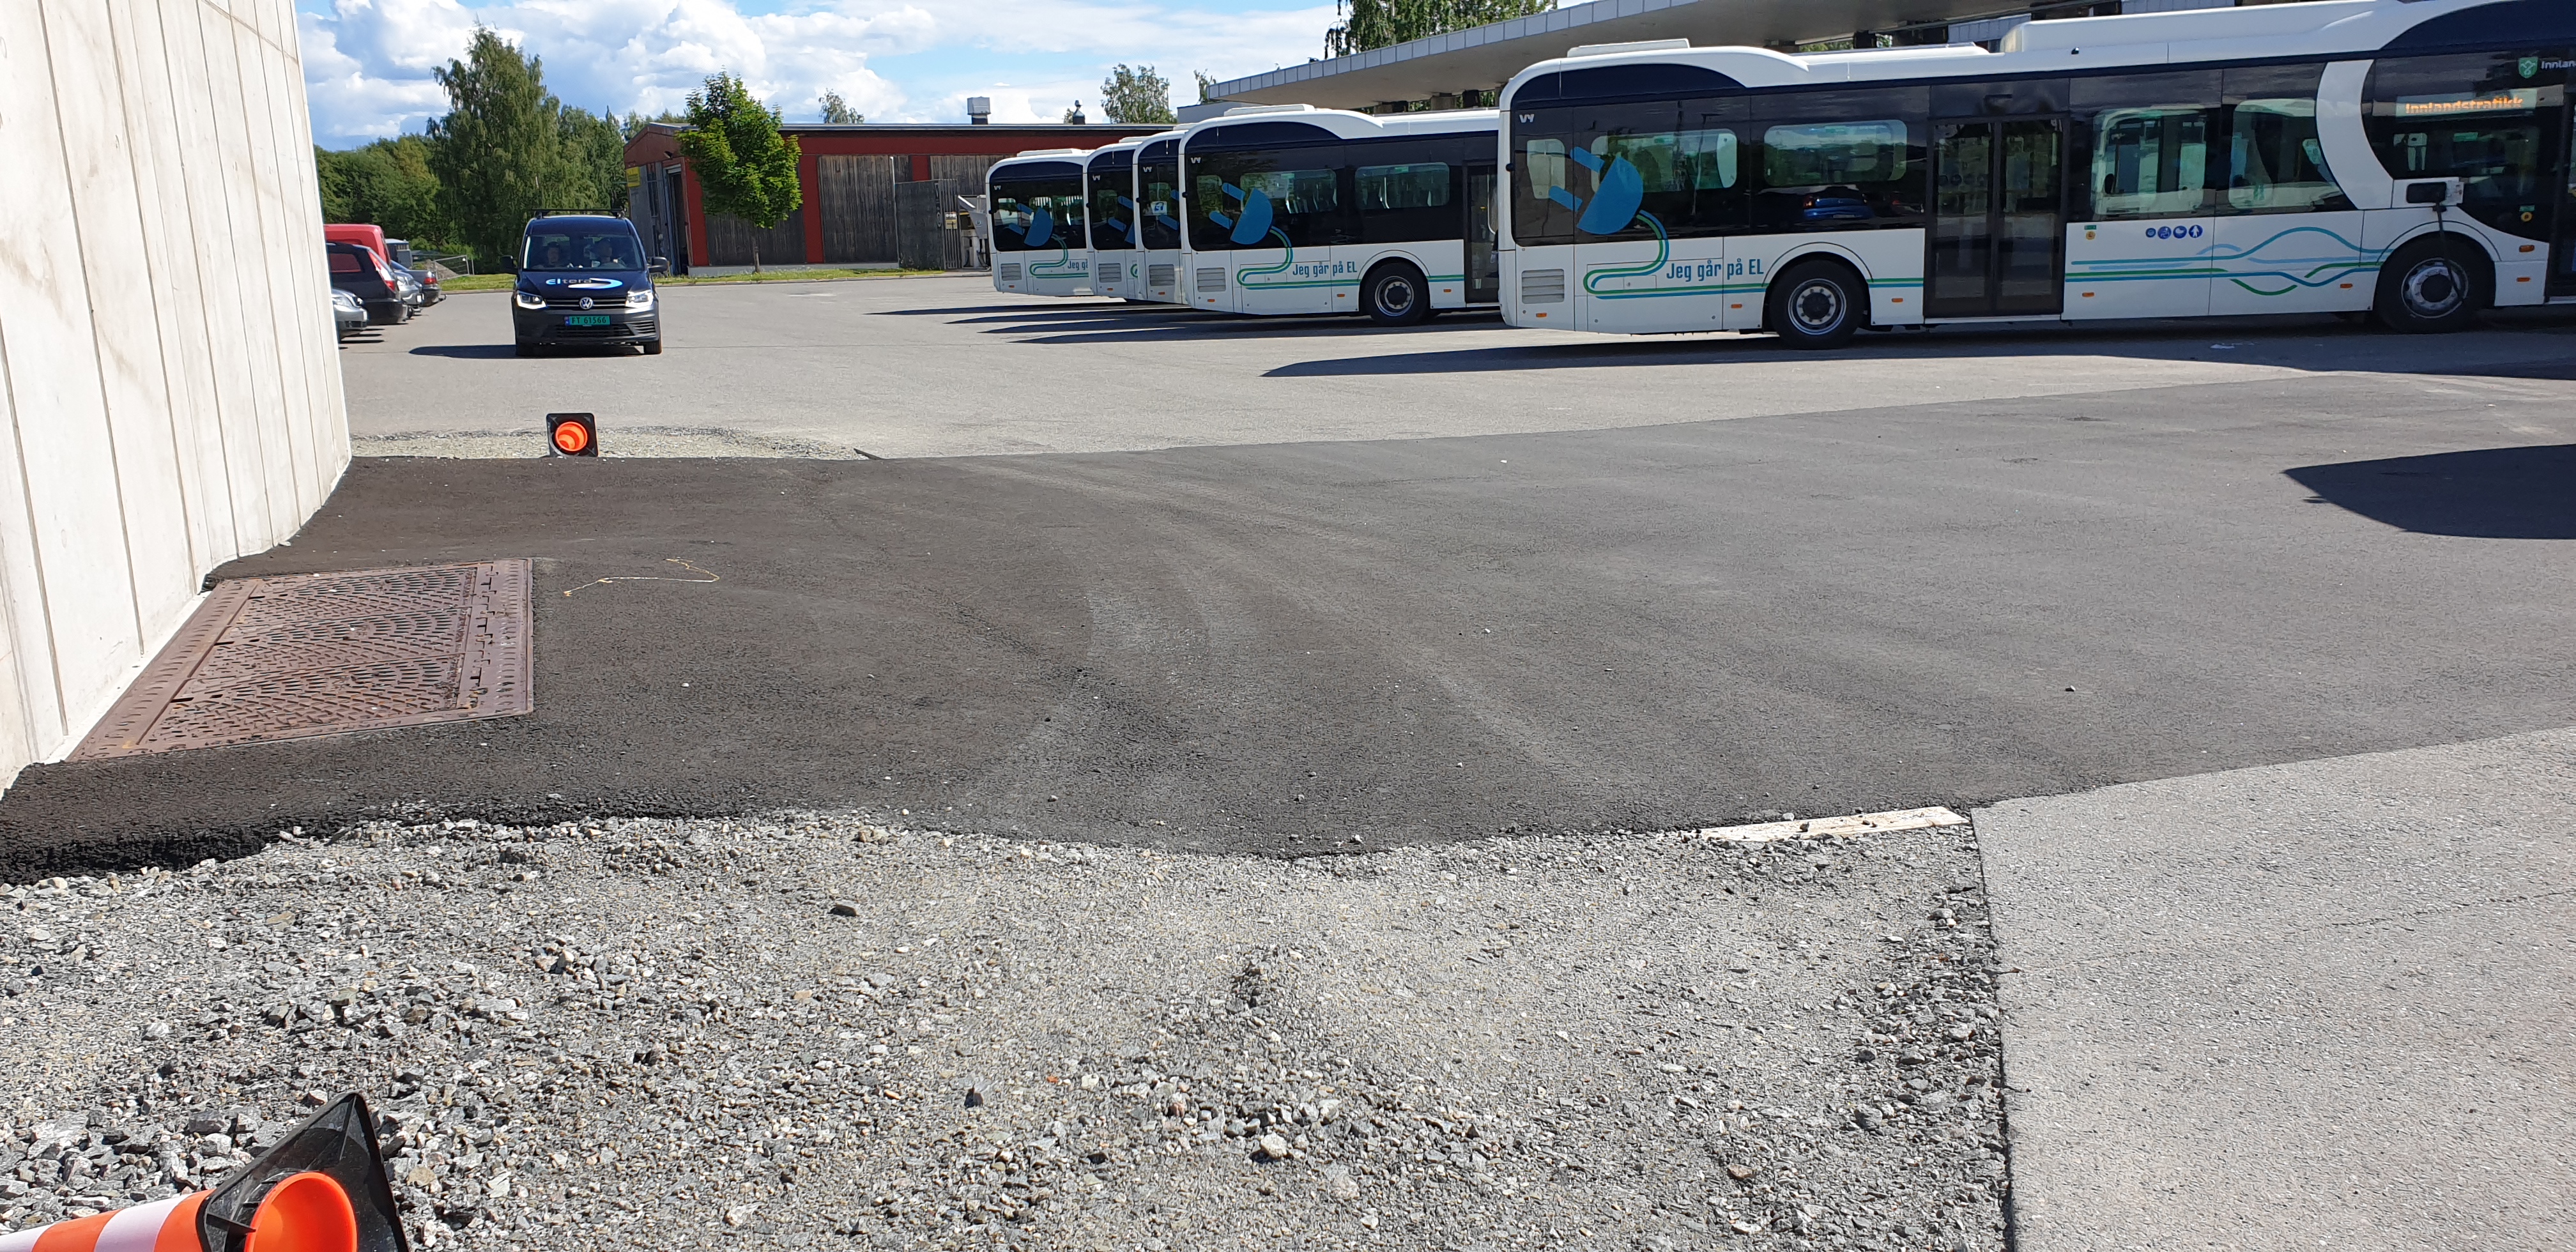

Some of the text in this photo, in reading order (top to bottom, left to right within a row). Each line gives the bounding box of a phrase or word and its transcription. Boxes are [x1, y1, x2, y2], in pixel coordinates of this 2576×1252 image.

[2541, 60, 2576, 69] Innlan
[2405, 95, 2523, 114] Innlandstrafikk
[1068, 261, 1079, 271] Jeg
[1292, 264, 1309, 278] Jeg
[1333, 261, 1344, 277] på
[1347, 261, 1358, 273] EL
[1666, 257, 1764, 282] Jeg går på EL
